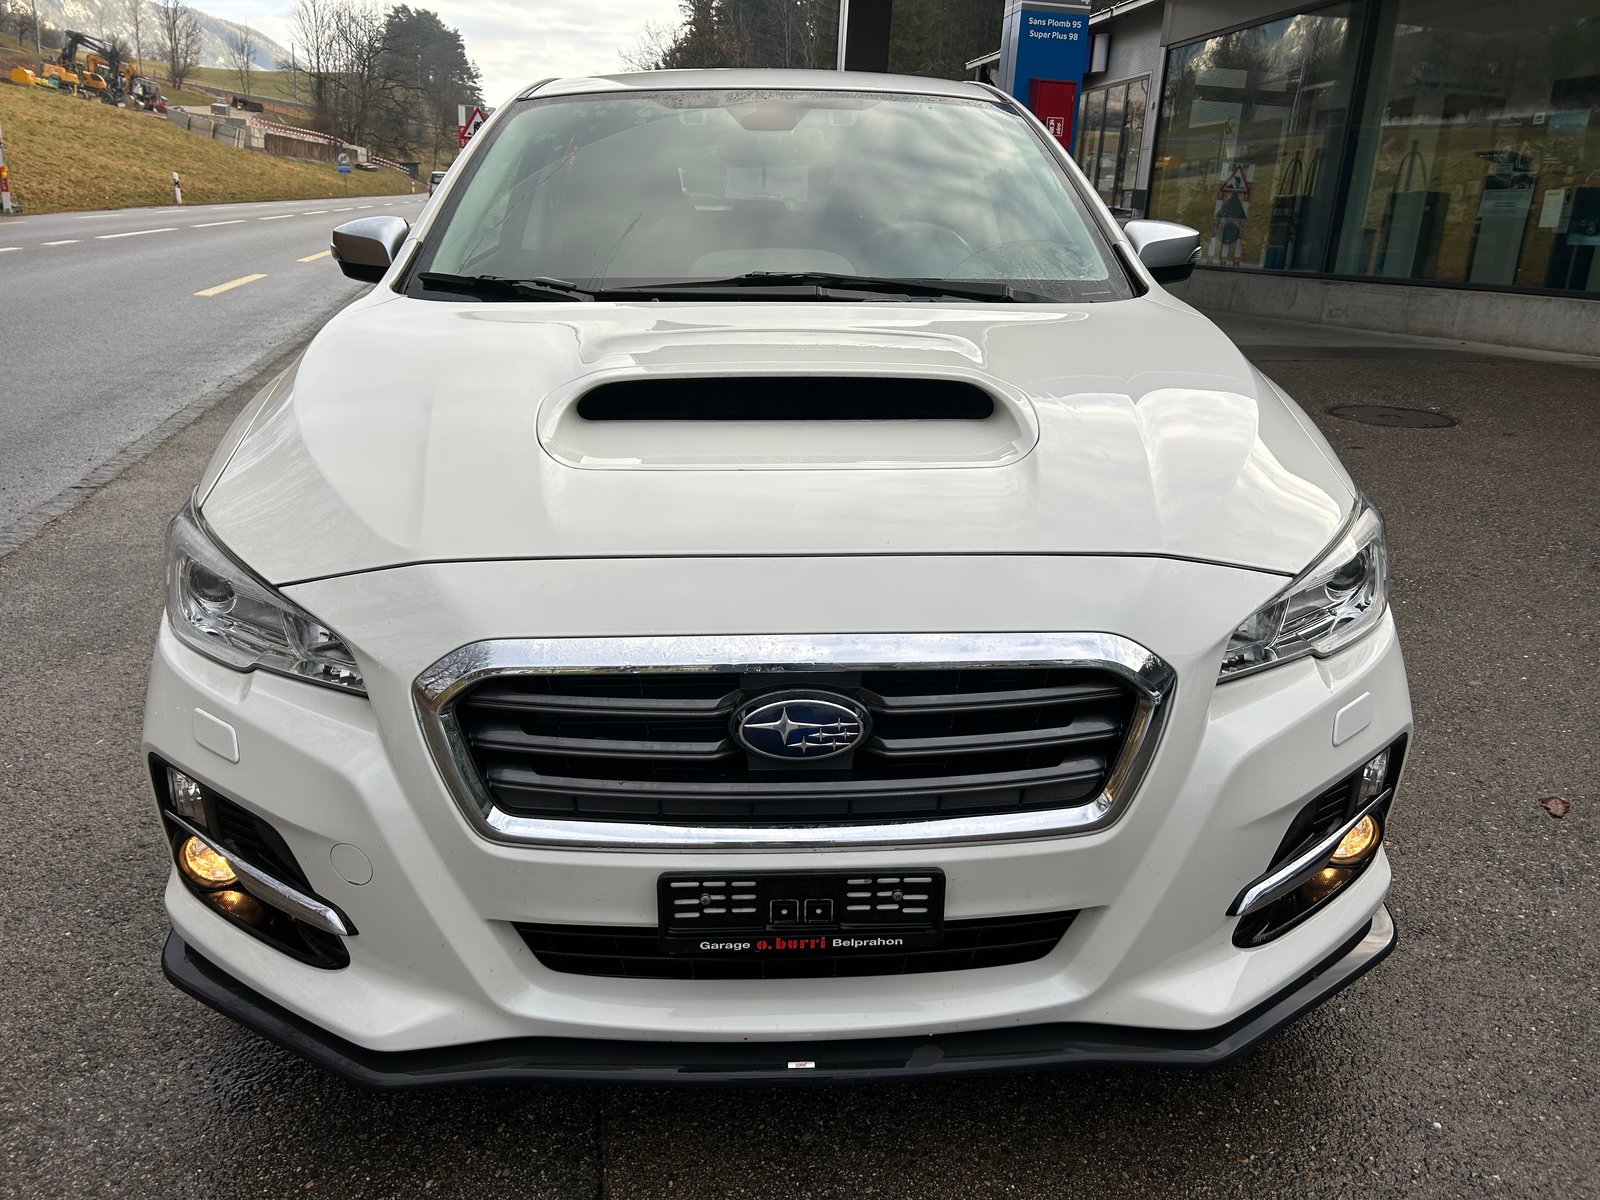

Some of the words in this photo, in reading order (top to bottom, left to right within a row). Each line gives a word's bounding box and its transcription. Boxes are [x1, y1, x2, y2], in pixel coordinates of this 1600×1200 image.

[1028, 17, 1046, 26] Sans
[1047, 19, 1071, 28] Plomb
[1072, 20, 1082, 29] 95
[1029, 30, 1051, 39] Super
[1051, 32, 1068, 40] Plus
[1068, 33, 1079, 41] 98
[699, 941, 751, 951] Garage
[832, 938, 903, 948] Belprahon
